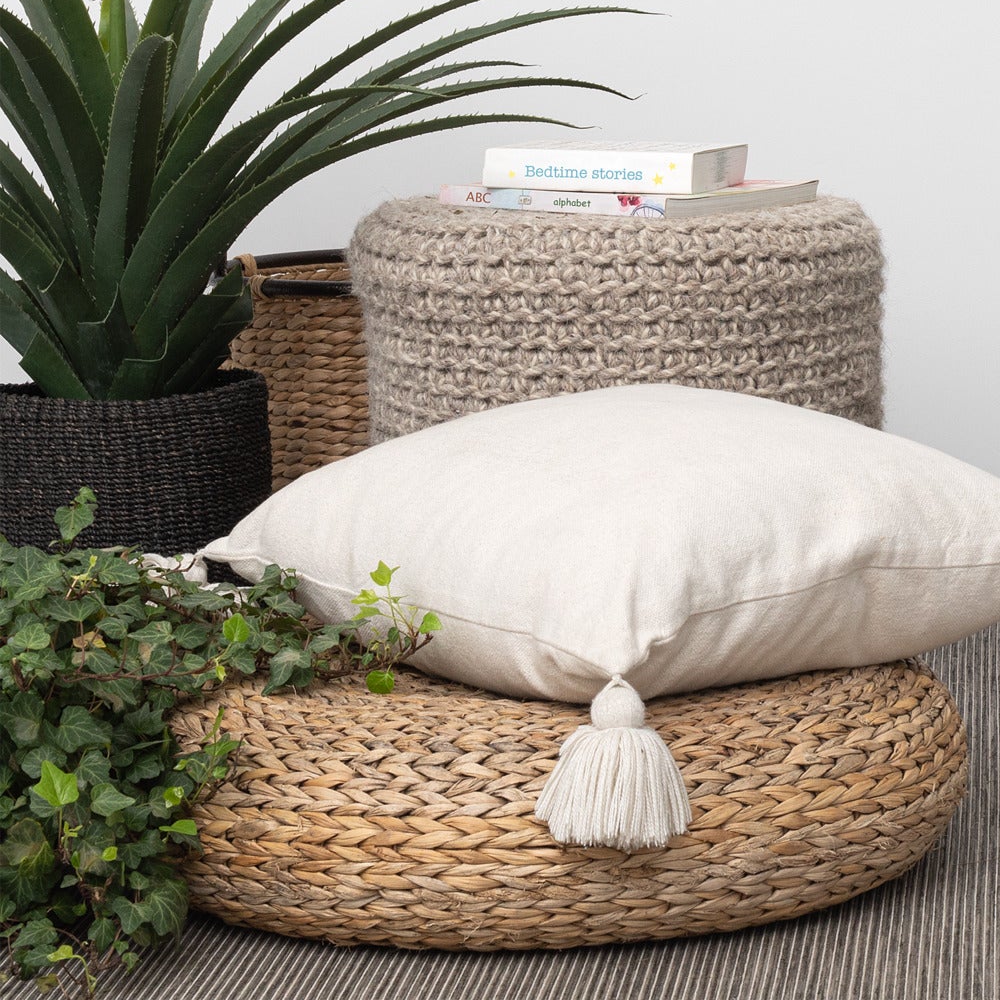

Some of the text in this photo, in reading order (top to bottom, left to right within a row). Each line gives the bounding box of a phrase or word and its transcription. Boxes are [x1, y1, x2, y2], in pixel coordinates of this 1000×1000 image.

[525, 165, 643, 181] Bedtime stories
[466, 191, 591, 209] ABC alphabet
